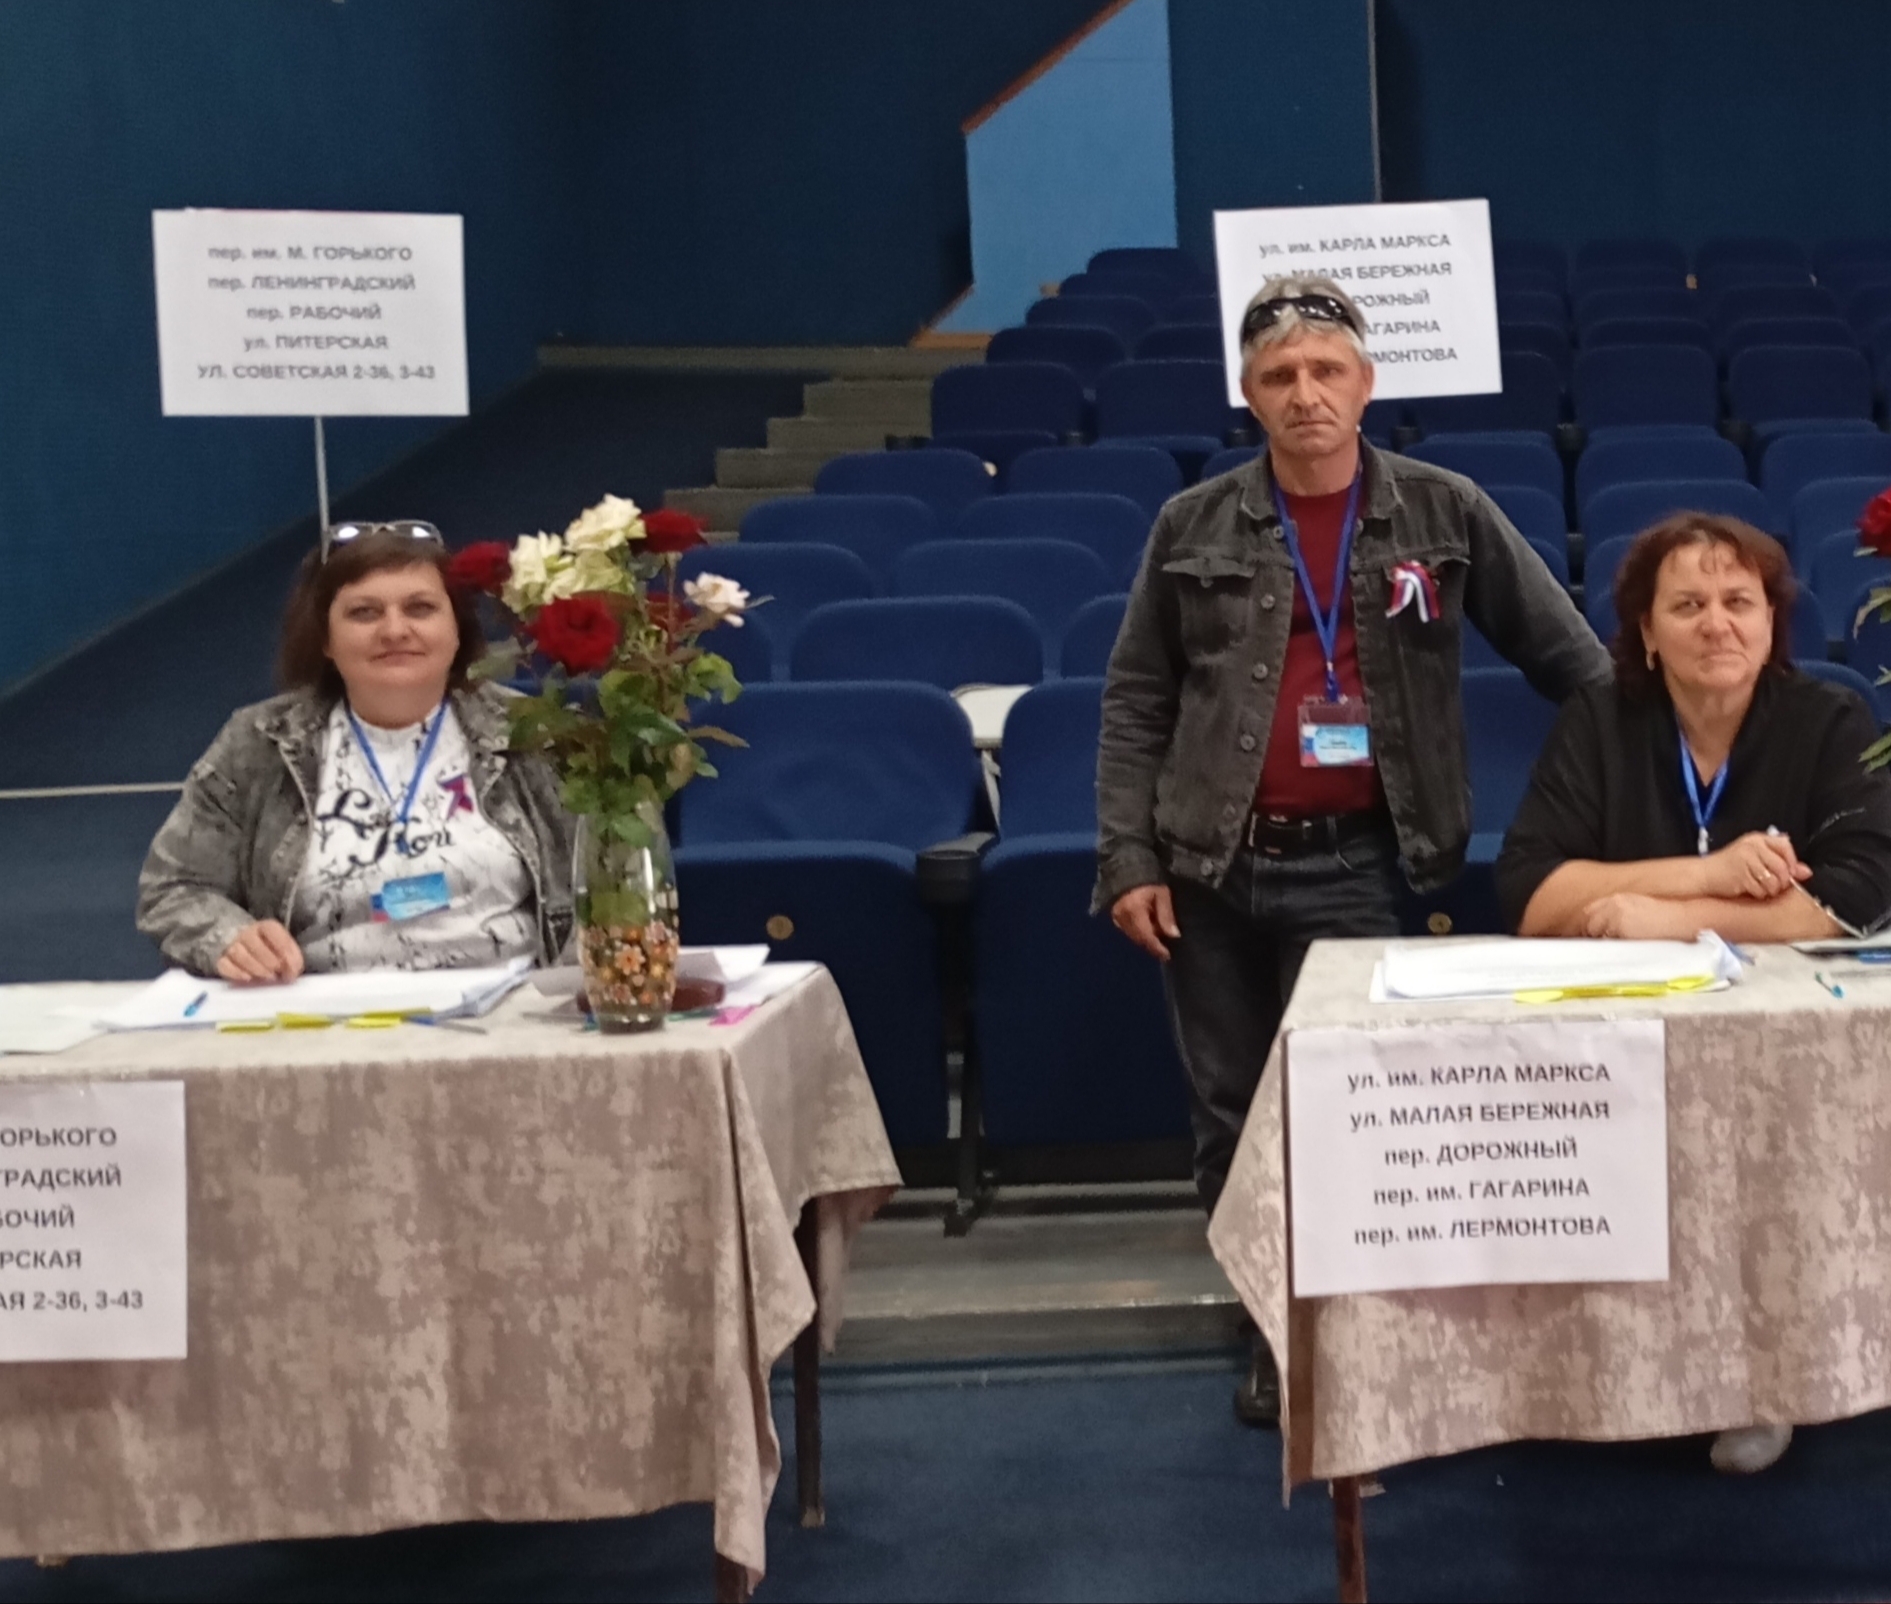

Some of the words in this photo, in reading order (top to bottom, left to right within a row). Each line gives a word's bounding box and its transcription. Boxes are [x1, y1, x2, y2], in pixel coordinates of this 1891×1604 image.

[207, 246, 247, 263] пер.
[286, 245, 307, 260] М.
[312, 245, 413, 262] ГОРЬКОГО
[1318, 236, 1377, 253] КАРЛА
[1379, 233, 1452, 250] МАРКСА
[1355, 261, 1453, 280] БЕРЕЖНАЯ
[207, 276, 247, 293] пер.
[250, 272, 417, 294] ЛЕНИНГРАДСКИЙ
[1351, 289, 1430, 308] РОЖНЫЙ
[245, 306, 285, 323] пер.
[288, 301, 383, 321] РАБОЧИЙ
[274, 334, 390, 351] ПИТЕРСКАЯ
[1368, 347, 1458, 364] МОНТОВА
[231, 363, 349, 380] СОВЕТСКАЯ
[398, 363, 436, 380] 3-43
[1347, 1073, 1381, 1095] ул.
[1387, 1069, 1425, 1087] им.
[1430, 1065, 1508, 1086] КАРЛА
[1514, 1062, 1612, 1083] МАРКСА
[1349, 1111, 1383, 1134] ул.
[1389, 1103, 1473, 1127] МАЛАЯ
[1479, 1099, 1610, 1122] БЕРЕЖНАЯ
[1384, 1148, 1430, 1169] пер.
[1436, 1135, 1578, 1167] ДОРОЖНЫЙ
[0, 1160, 123, 1194] РАДСКИЙ
[1373, 1188, 1419, 1208] пер.
[1426, 1185, 1462, 1202] им.
[1469, 1177, 1590, 1200] ГАГАРИНА
[0, 1202, 77, 1229] ОЧИЙ
[1354, 1227, 1400, 1249] пер.
[1406, 1224, 1443, 1242] им.
[1450, 1215, 1611, 1239] ЛЕРМОНТОВА
[32, 1290, 88, 1313] 2-36,
[94, 1289, 144, 1311] 3-43
